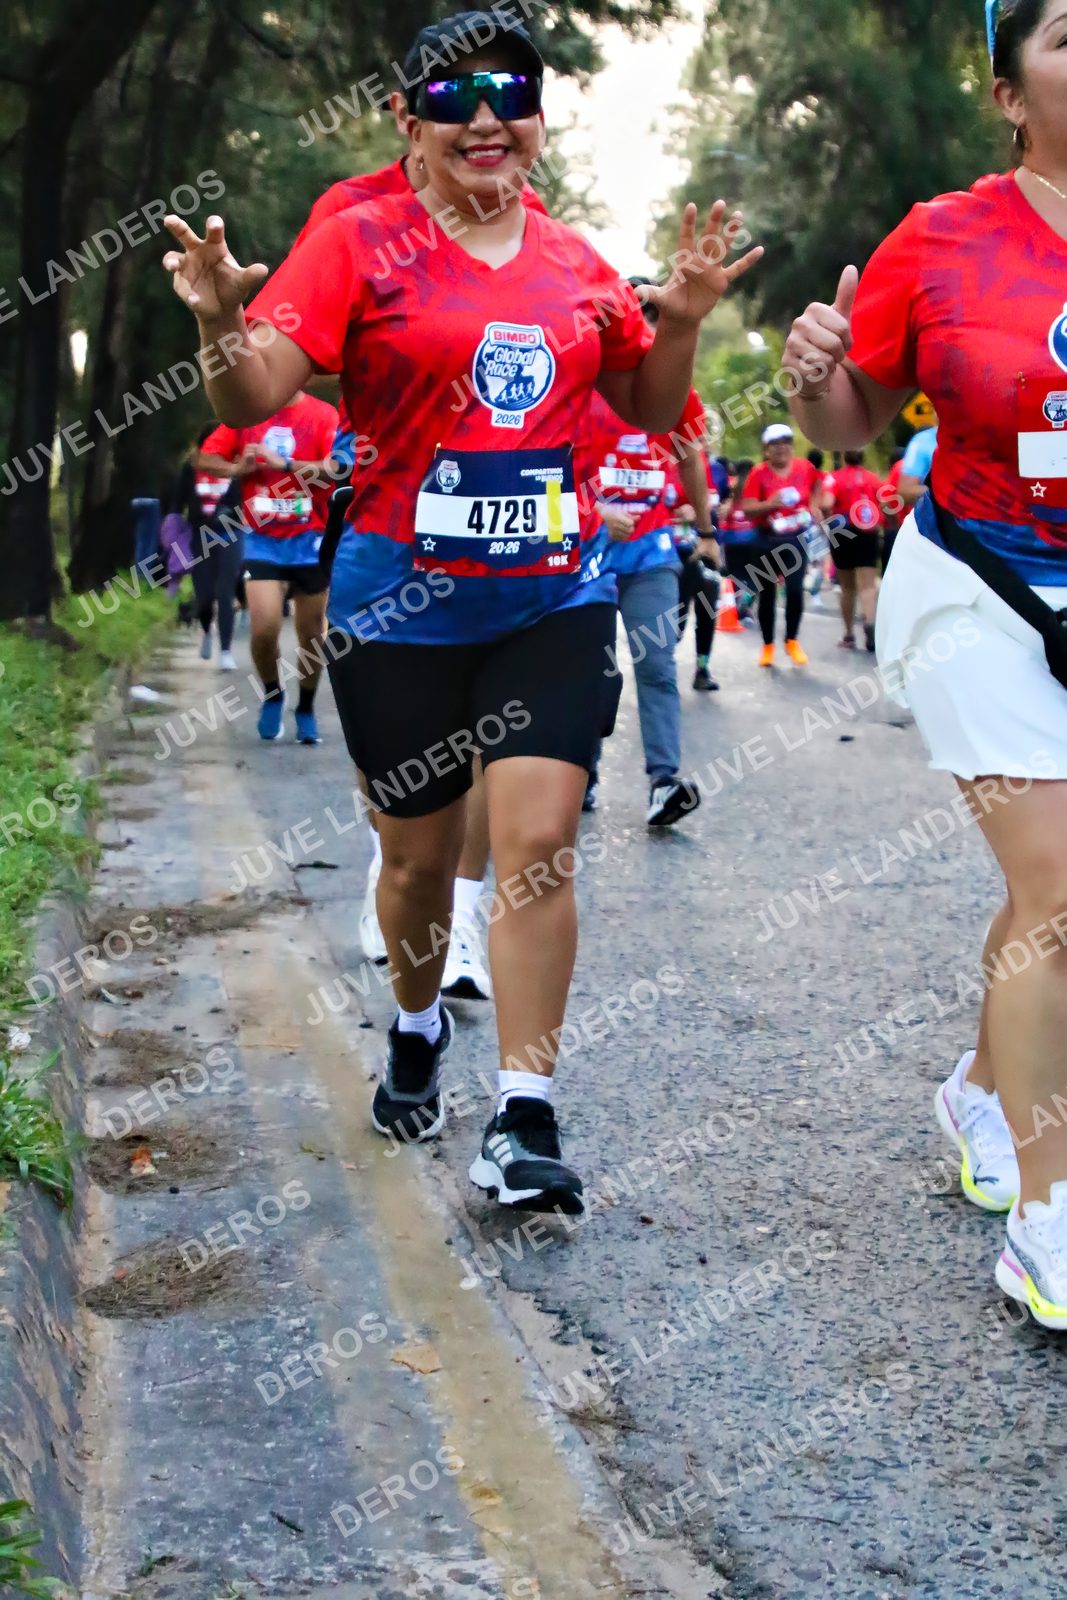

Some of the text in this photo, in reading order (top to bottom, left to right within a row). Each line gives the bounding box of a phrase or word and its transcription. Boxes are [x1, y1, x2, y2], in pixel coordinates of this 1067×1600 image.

[494, 331, 537, 344] BIMBO
[494, 347, 537, 366] Global
[485, 360, 518, 377] Race
[495, 413, 521, 425] 2026
[467, 498, 537, 534] 4729
[547, 555, 569, 567] 10K
